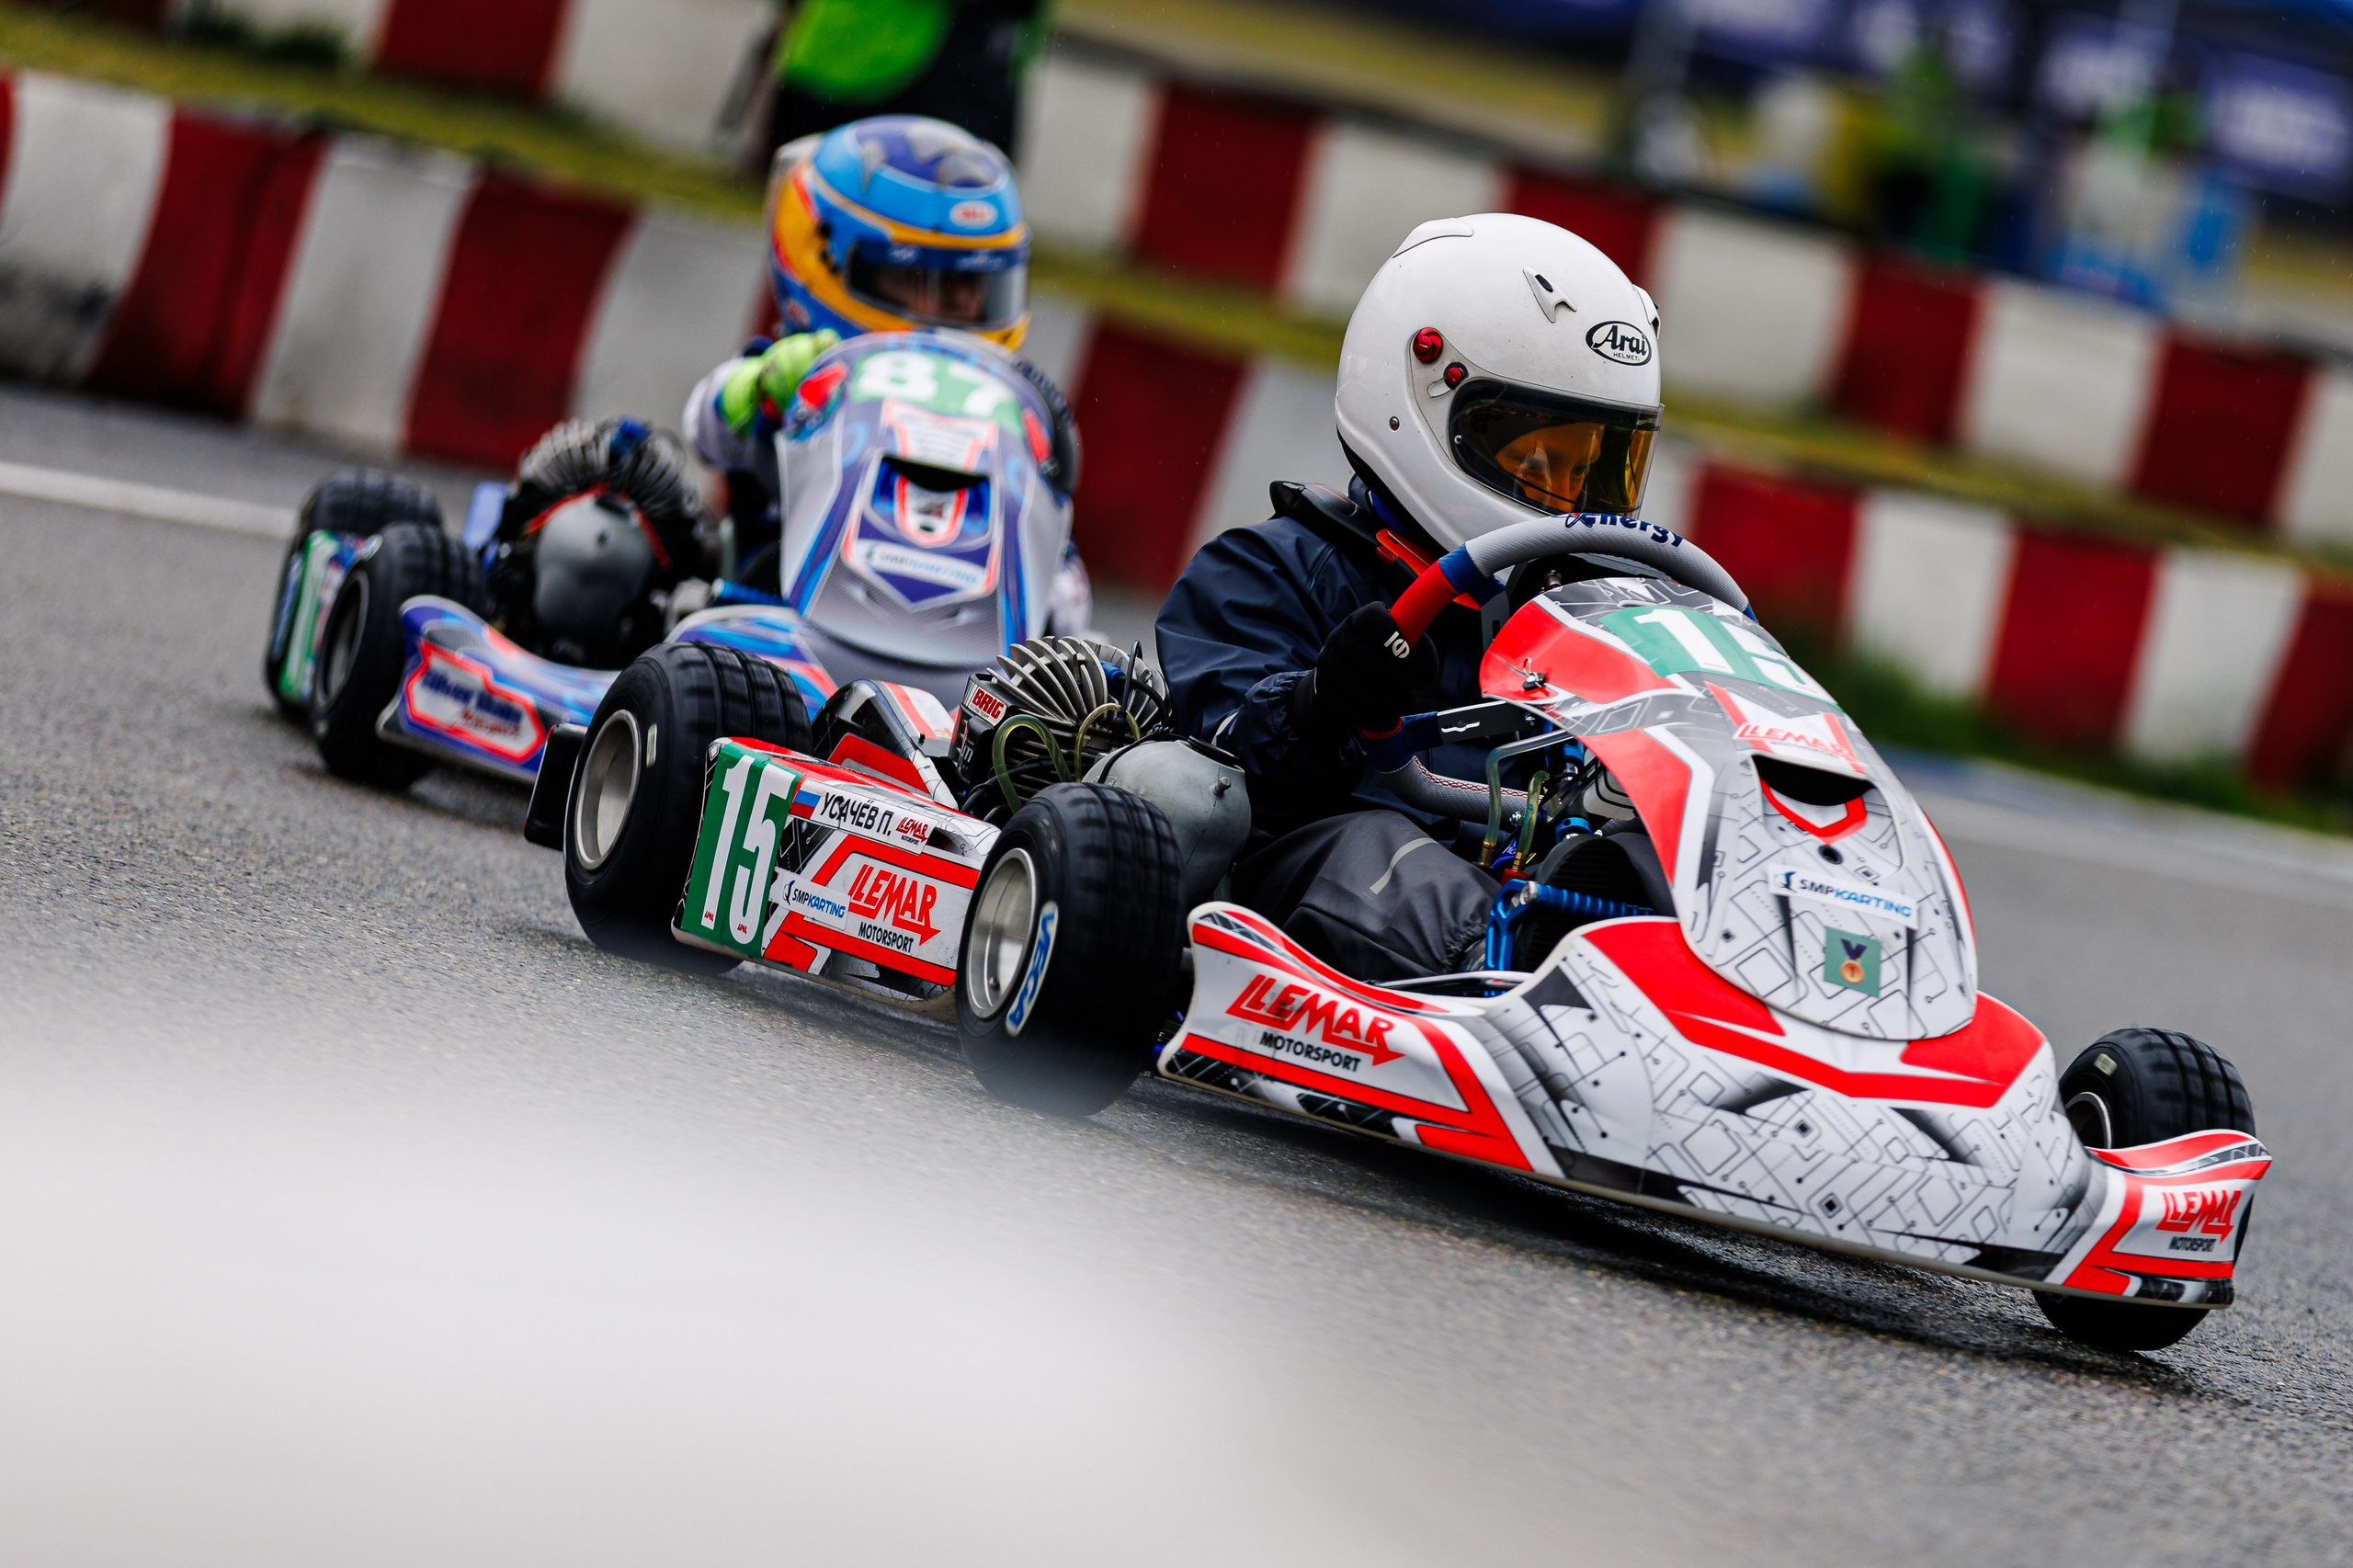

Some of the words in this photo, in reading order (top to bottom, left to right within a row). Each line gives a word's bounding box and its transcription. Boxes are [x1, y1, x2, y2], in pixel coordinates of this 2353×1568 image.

[1592, 324, 1647, 356] Arai
[858, 349, 1011, 416] 87
[972, 687, 1005, 720] BRIG
[820, 792, 879, 830] УСАЧЁВ
[876, 810, 895, 836] П.
[701, 754, 797, 945] 15
[858, 922, 914, 953] MOTORSPORT
[1259, 1031, 1361, 1073] MOTORSPORT
